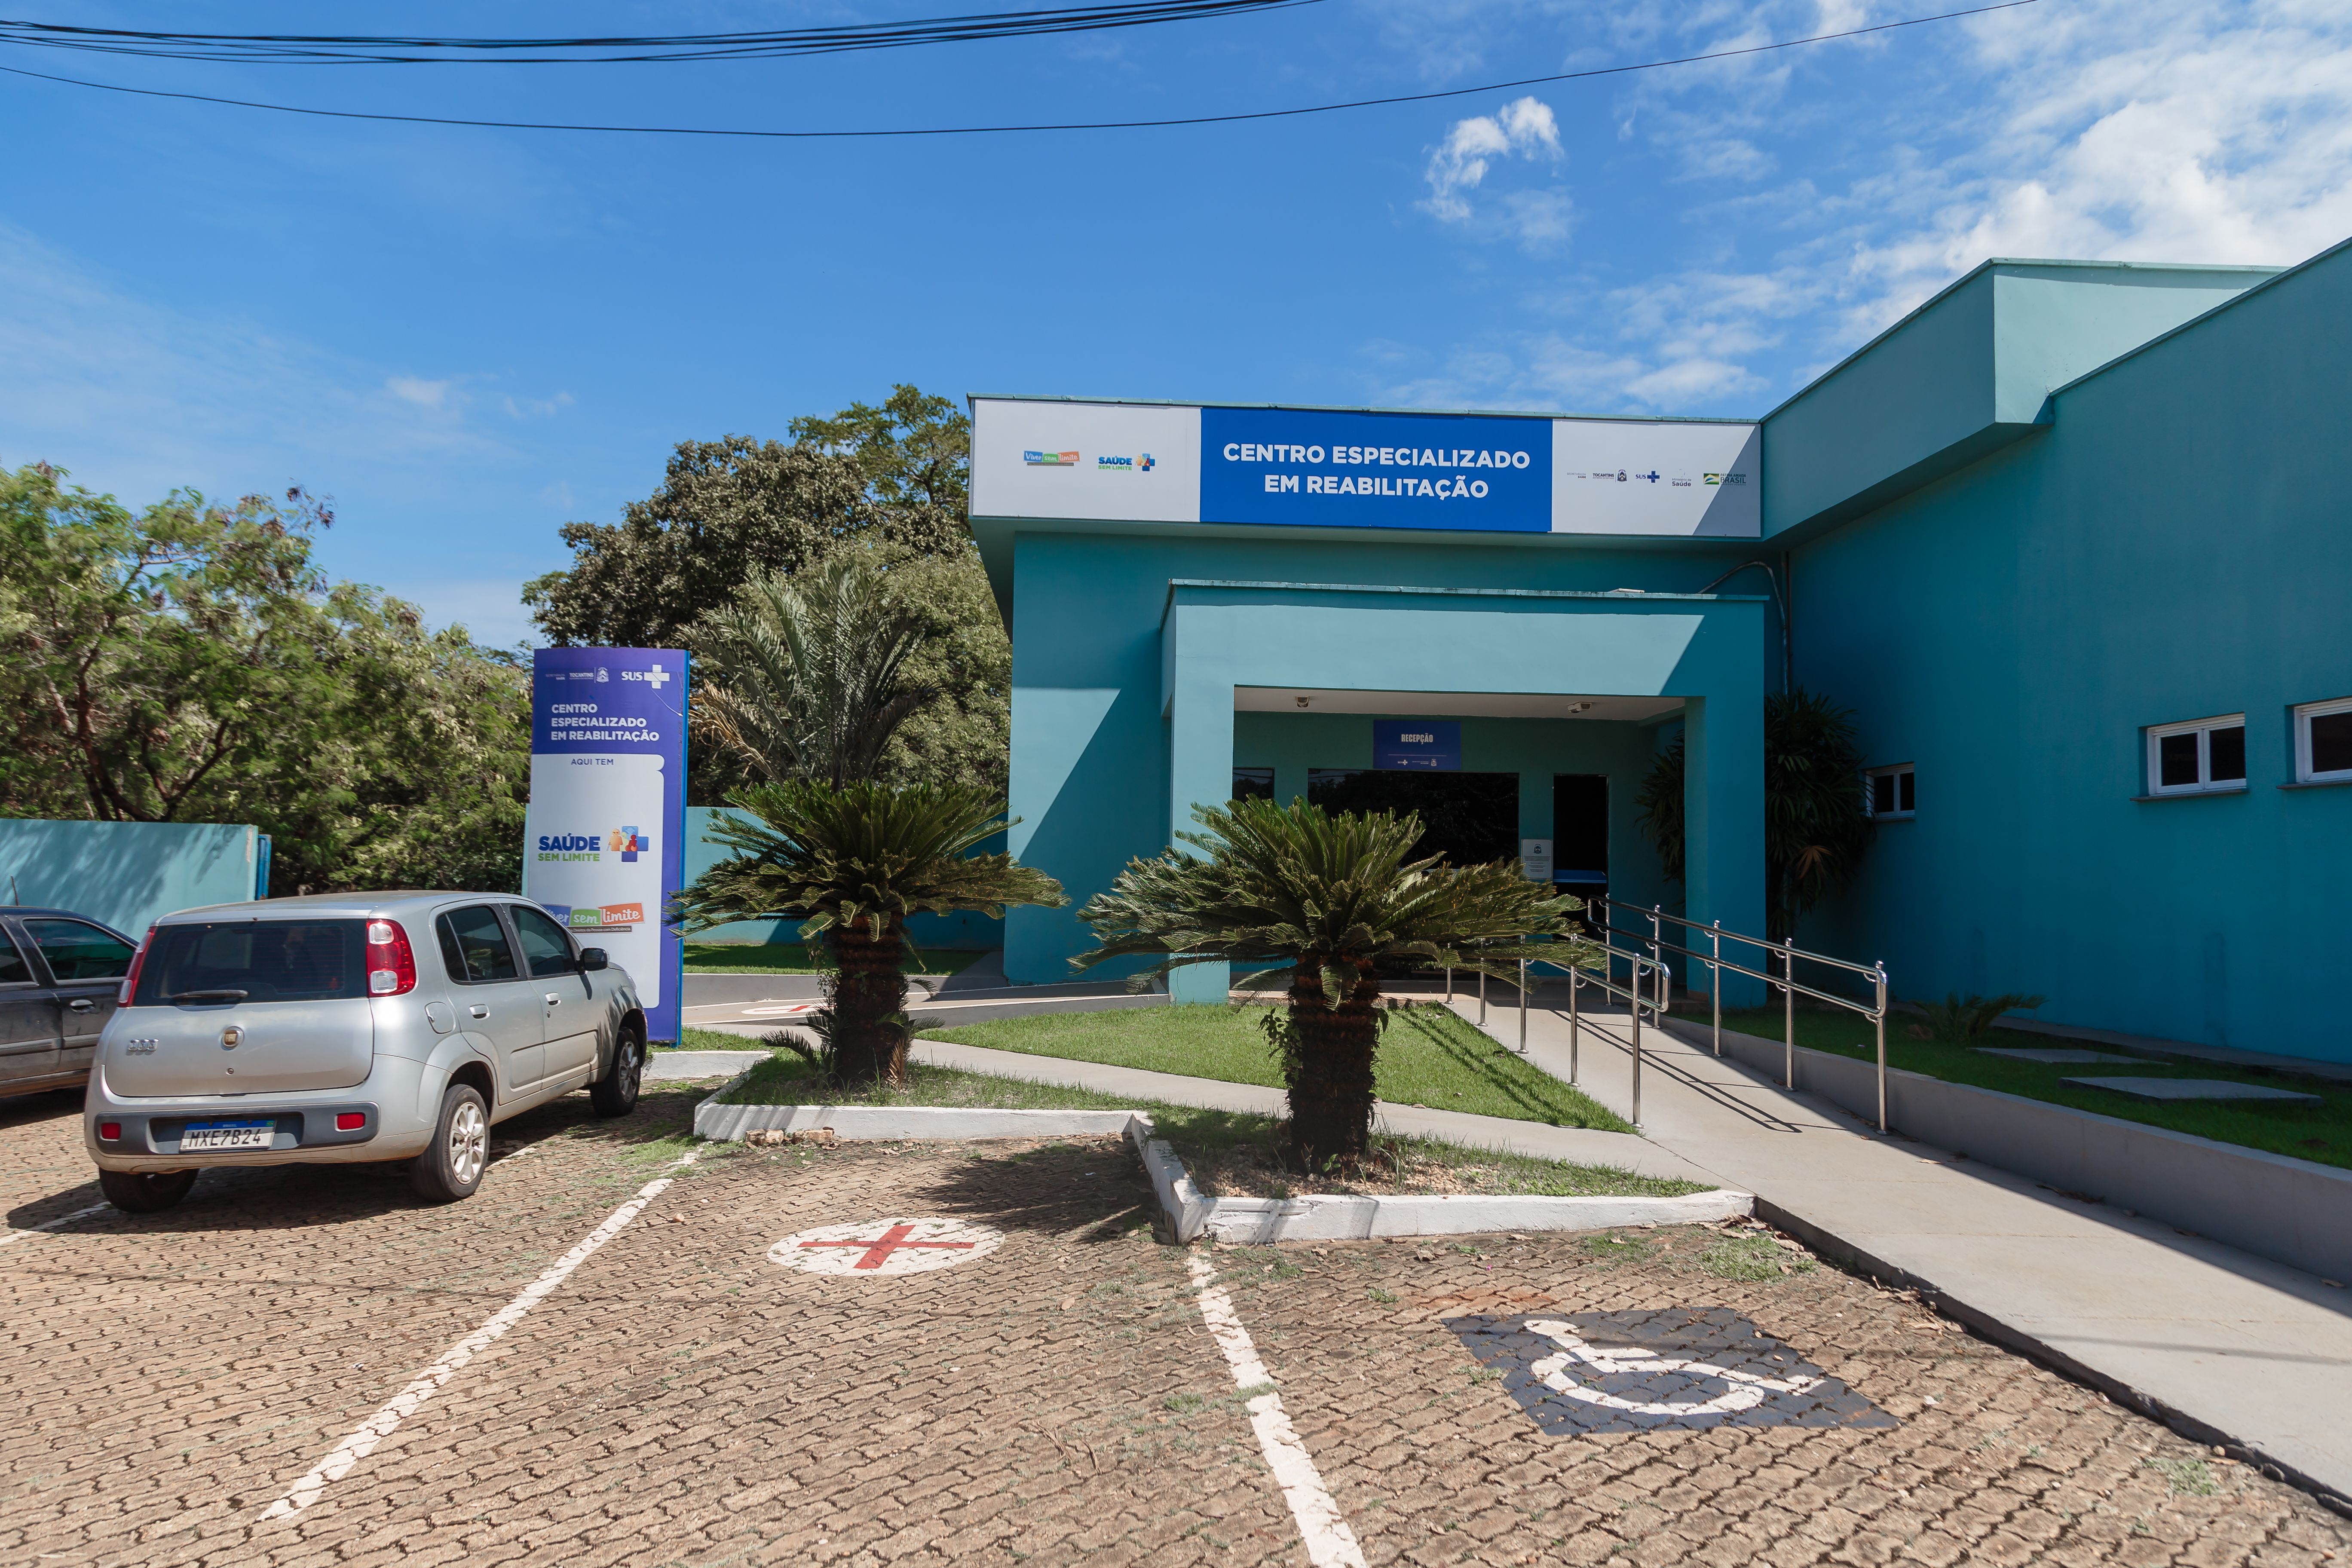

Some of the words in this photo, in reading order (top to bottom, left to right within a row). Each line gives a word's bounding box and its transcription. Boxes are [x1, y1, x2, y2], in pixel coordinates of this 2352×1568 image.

[1026, 452, 1042, 460] Viver
[1098, 456, 1132, 465] SAÚDE
[1223, 443, 1325, 463] CENTRO
[1333, 446, 1530, 469] ESPECIALIZADO
[1265, 475, 1299, 493] EM
[1307, 475, 1488, 501] REABILITAÇÃO
[621, 671, 643, 681] SUS
[551, 704, 598, 714] CENTRO
[551, 717, 647, 727] ESPECIALIZADO
[551, 731, 567, 740] EM
[569, 729, 660, 742] REABILITAÇÃO
[1401, 733, 1433, 744] RECEPÇÃO
[538, 833, 600, 851] SAÚDE
[538, 853, 559, 861] SEM
[563, 853, 600, 861] LIMITE
[573, 914, 599, 924] sem
[603, 909, 640, 923] limite
[189, 1129, 261, 1147] MXE7B24
